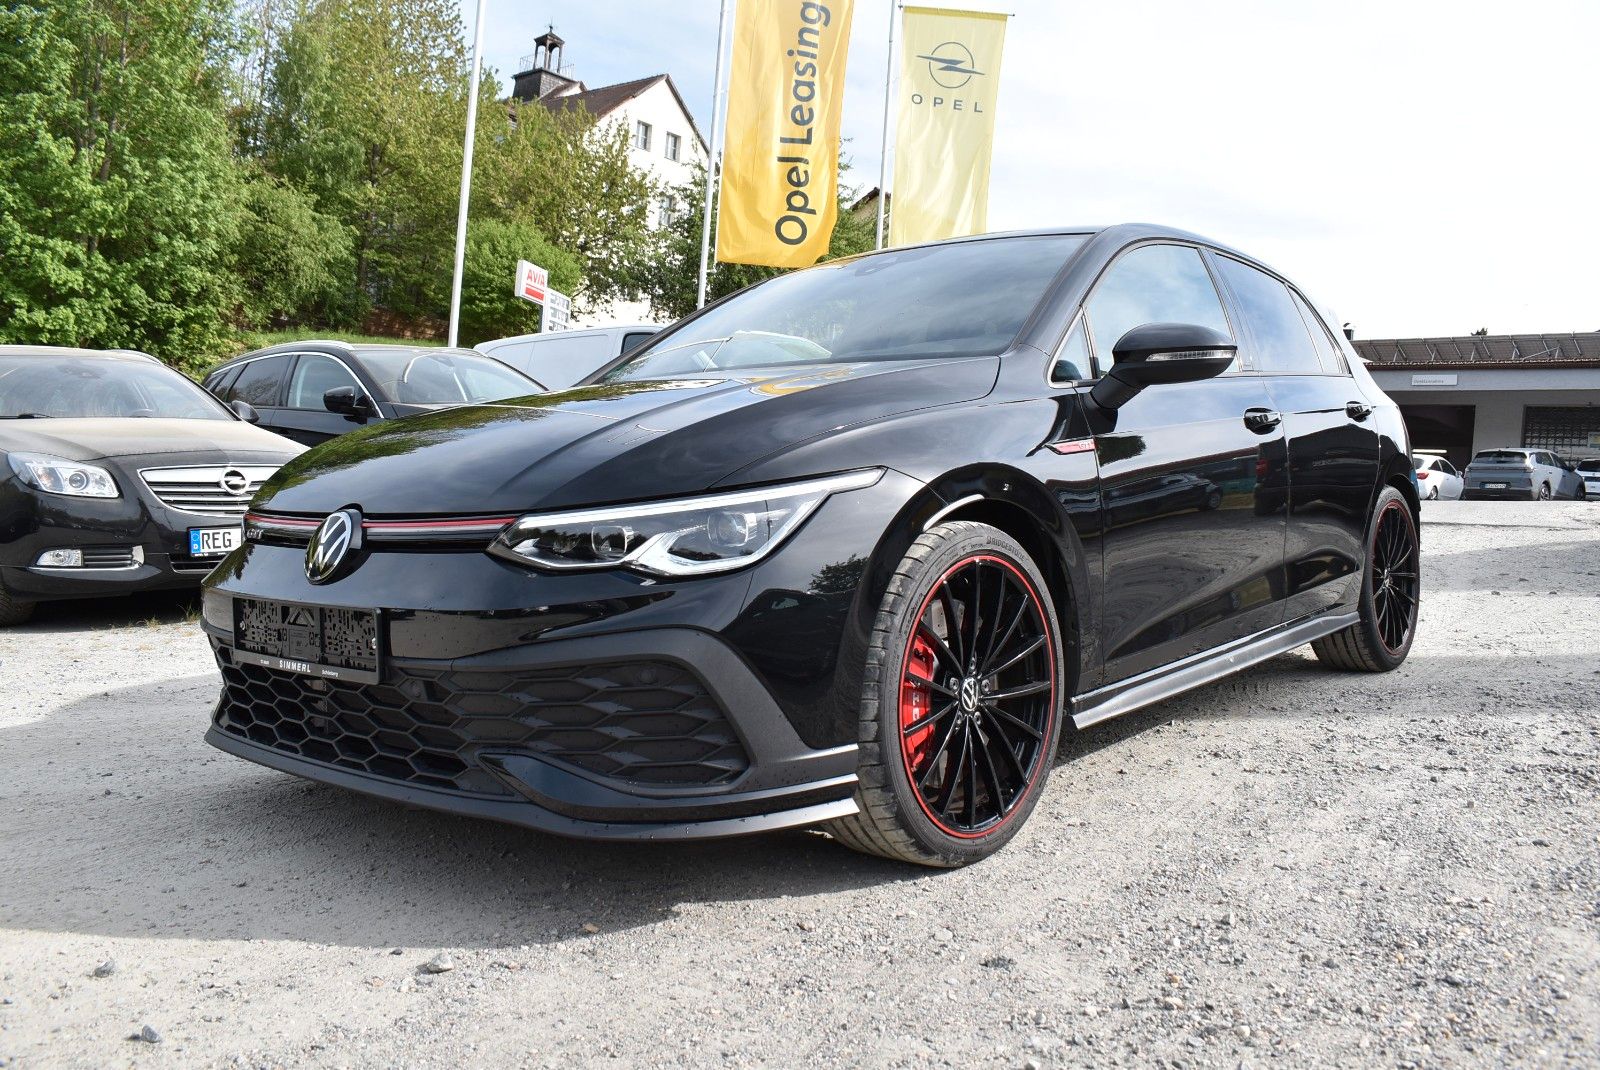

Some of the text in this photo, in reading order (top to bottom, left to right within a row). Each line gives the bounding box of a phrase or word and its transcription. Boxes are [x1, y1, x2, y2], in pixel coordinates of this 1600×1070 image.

[911, 93, 983, 113] OPEL
[775, 1, 831, 246] Opel Leasing
[526, 268, 546, 288] AVIA
[201, 531, 232, 550] REG
